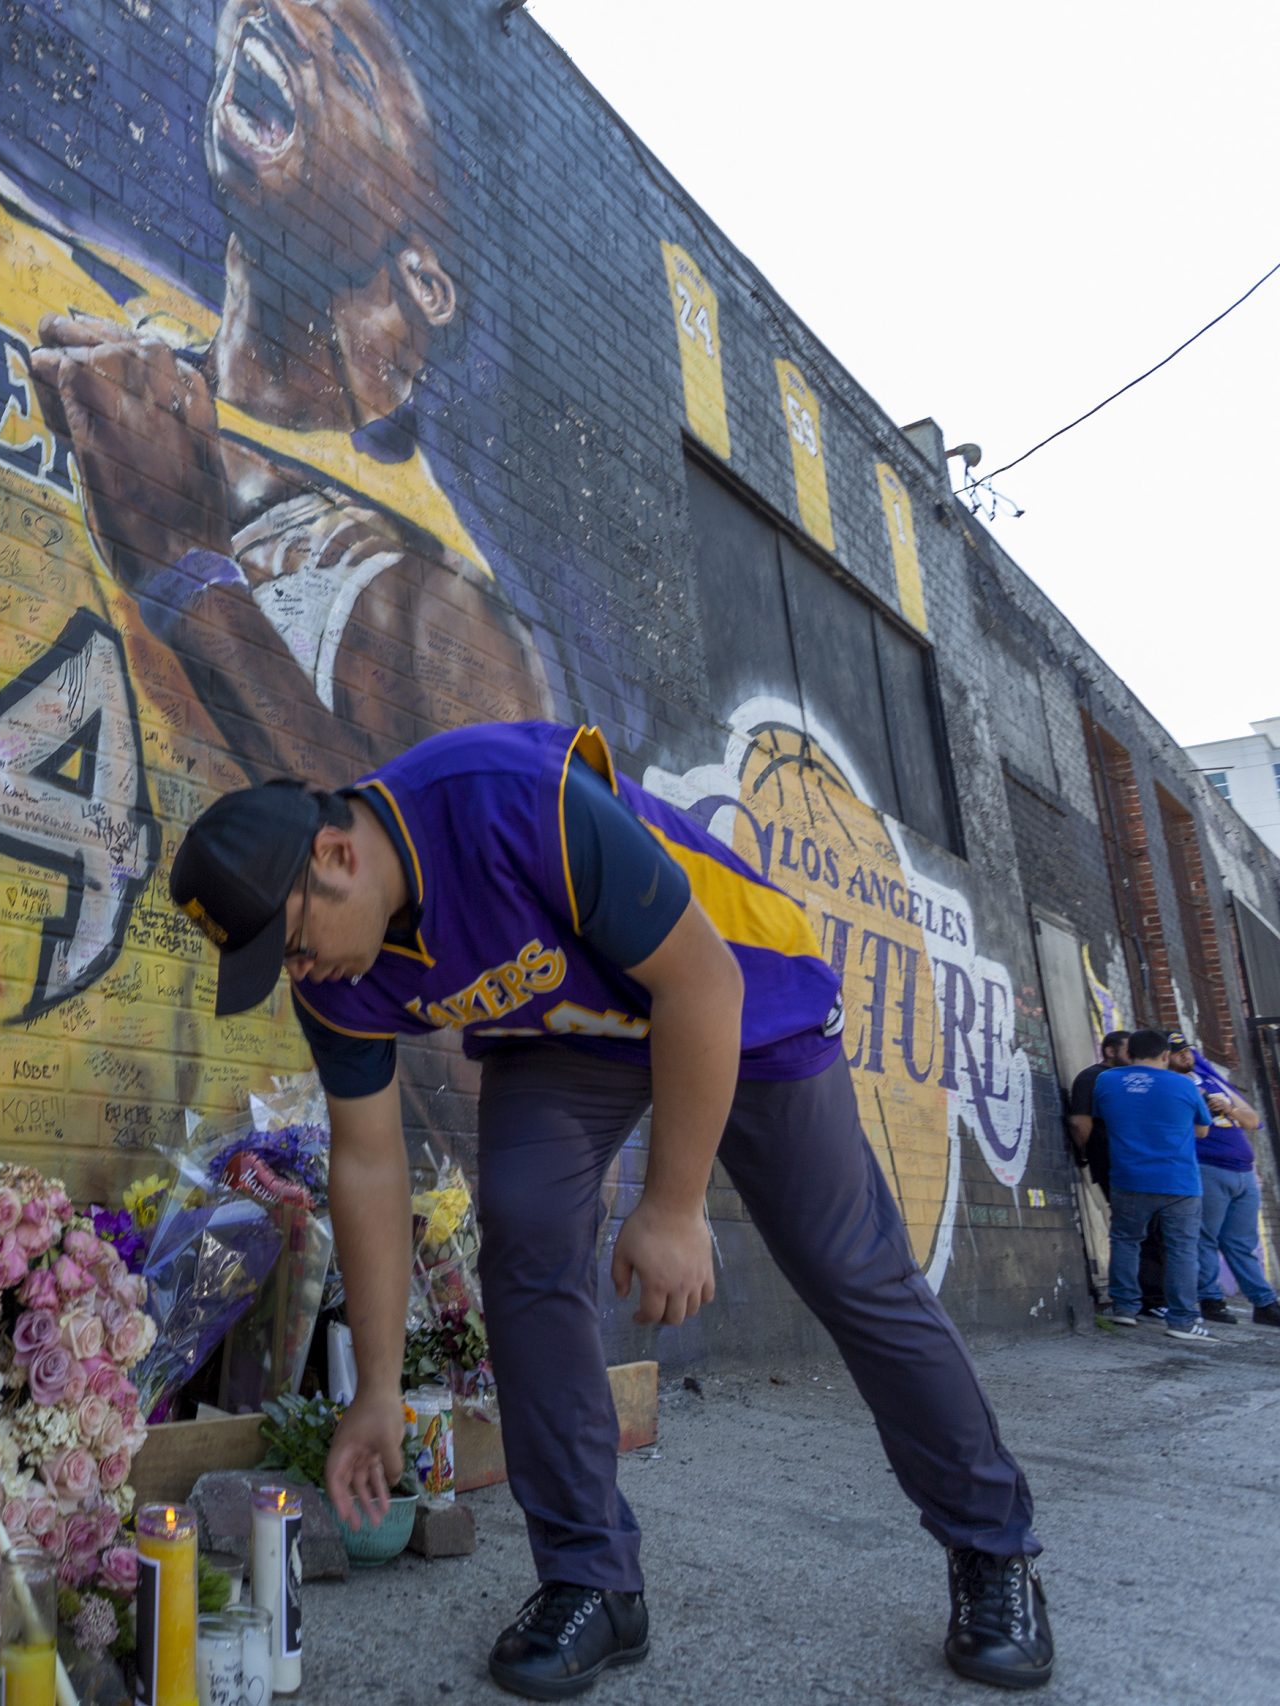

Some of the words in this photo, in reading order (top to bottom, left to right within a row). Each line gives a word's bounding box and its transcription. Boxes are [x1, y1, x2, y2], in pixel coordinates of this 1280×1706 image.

[675, 279, 715, 357] 24
[779, 826, 840, 890] LOS
[846, 864, 968, 947] ANGELES
